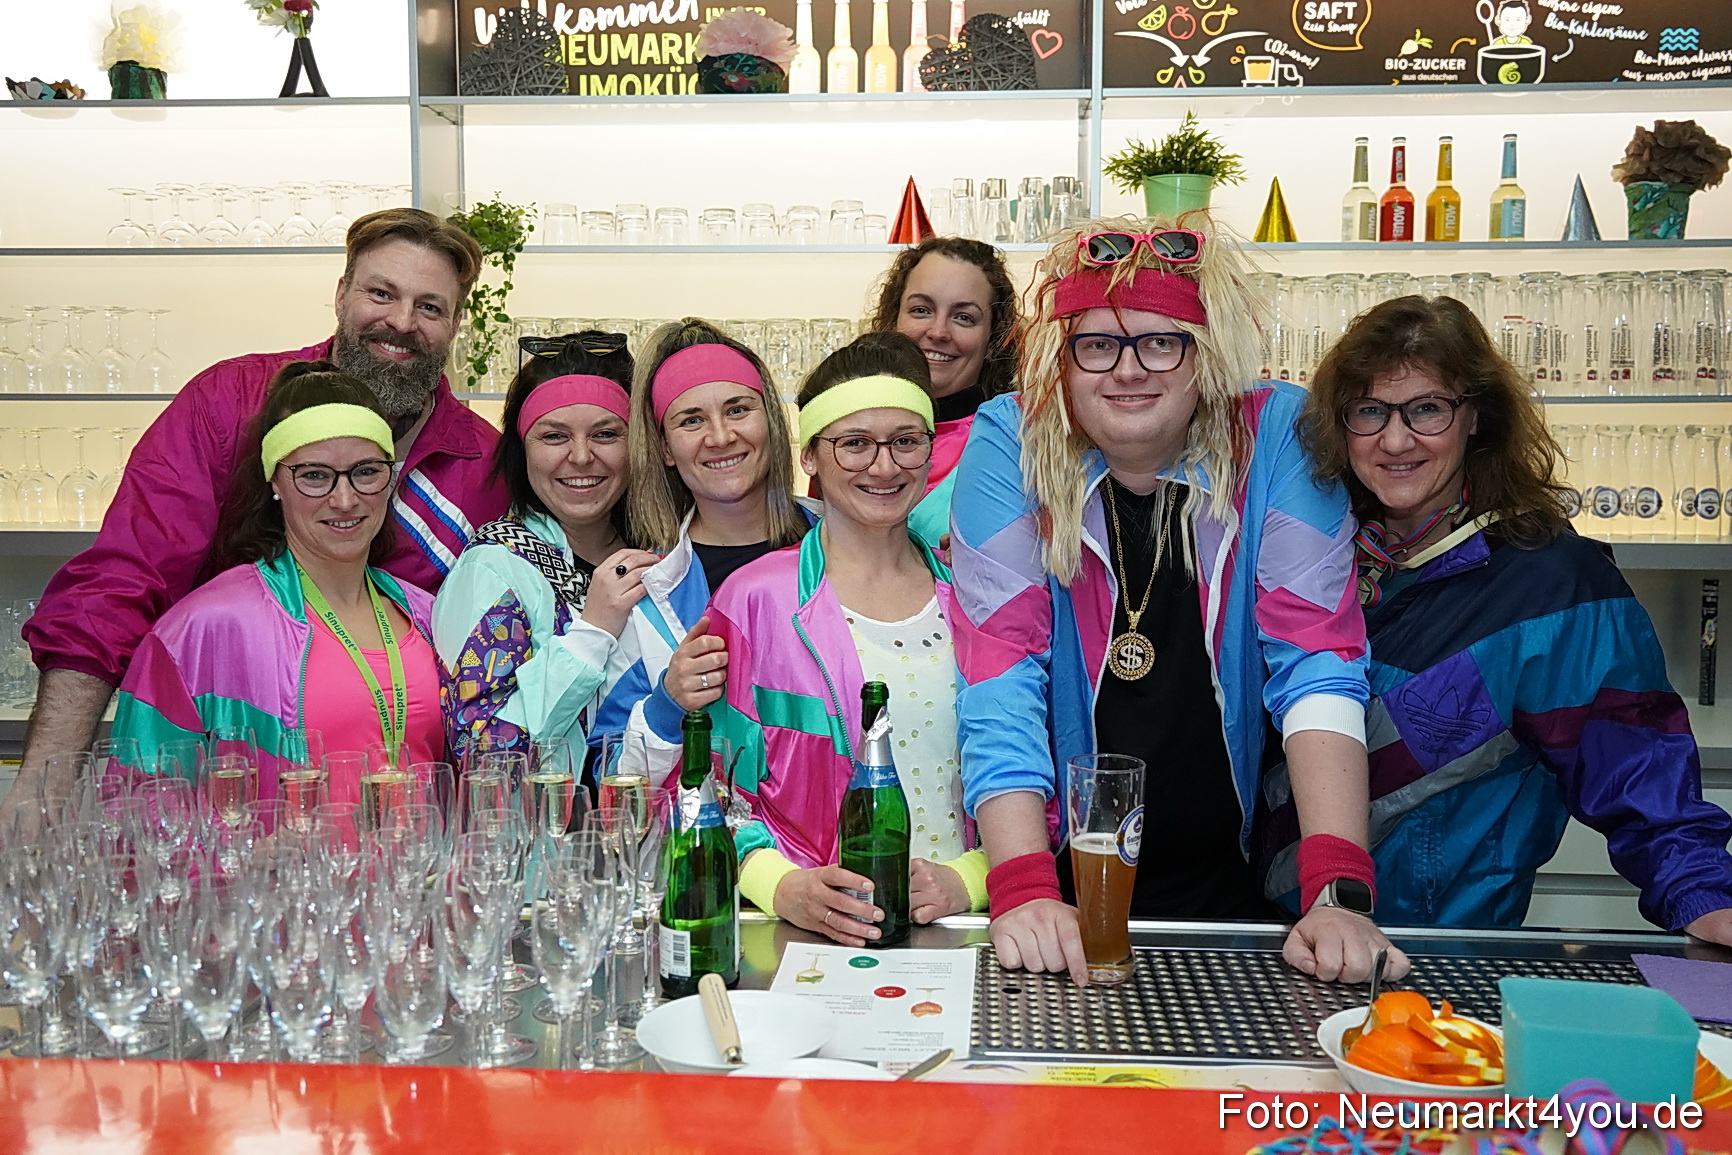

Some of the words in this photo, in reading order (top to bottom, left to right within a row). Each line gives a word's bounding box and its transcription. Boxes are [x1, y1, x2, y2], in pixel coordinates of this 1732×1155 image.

[1304, 2, 1358, 20] SAFT
[1581, 2, 1624, 21] eigene
[1544, 11, 1649, 40] Bio-Kohlensäure
[1384, 58, 1466, 71] BIO-ZUCKER
[1622, 69, 1645, 82] aus
[1645, 70, 1690, 82] unserer
[1691, 65, 1732, 81] eigenen
[1402, 73, 1417, 81] aus
[1417, 72, 1459, 81] deutschen
[1392, 205, 1406, 229] now
[1443, 204, 1456, 230] now
[1511, 202, 1523, 227] now
